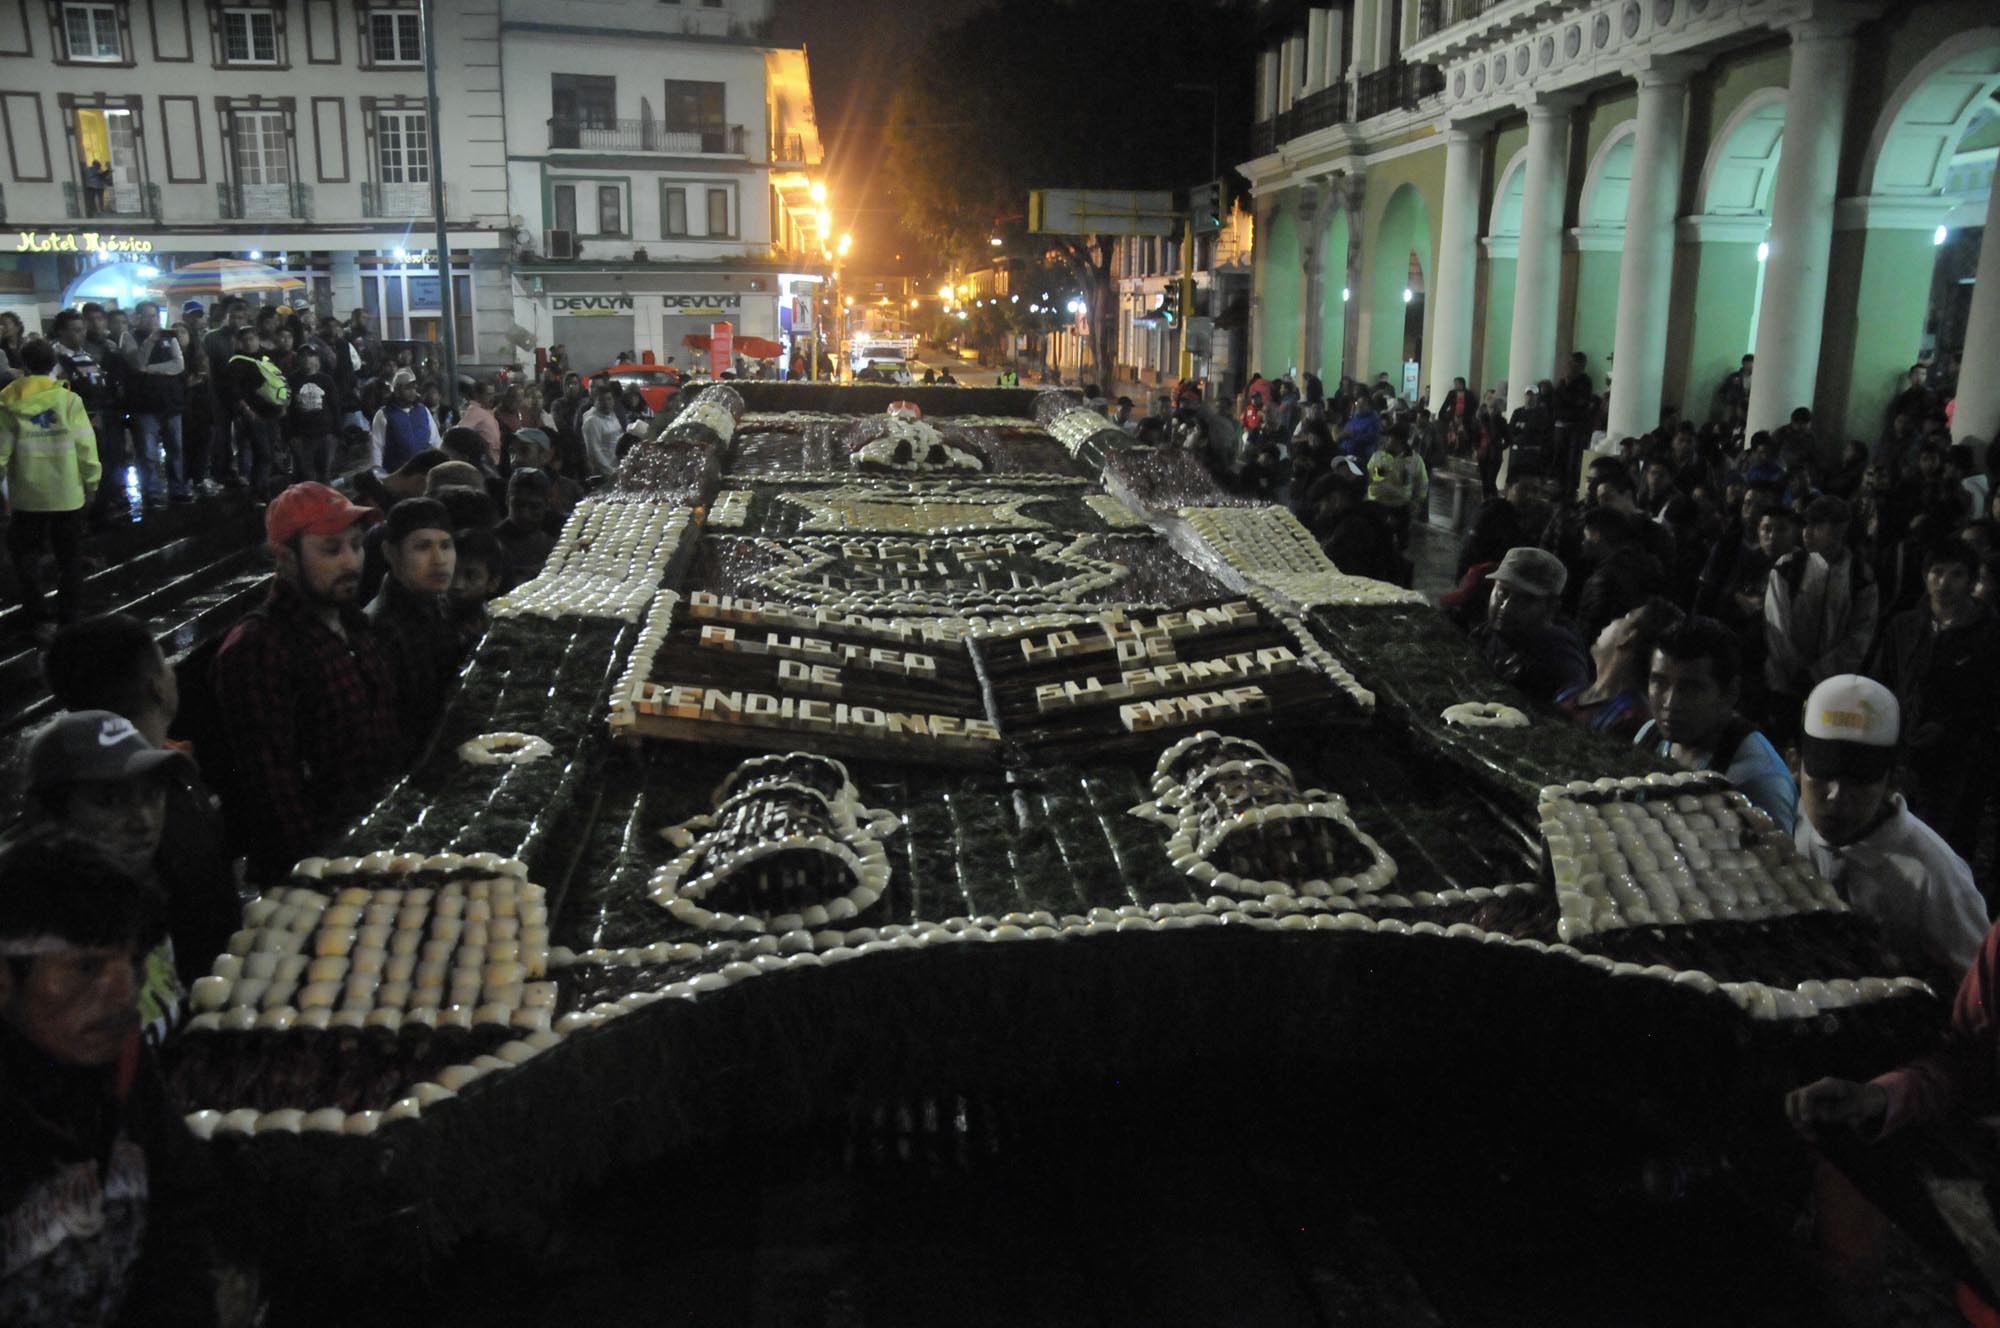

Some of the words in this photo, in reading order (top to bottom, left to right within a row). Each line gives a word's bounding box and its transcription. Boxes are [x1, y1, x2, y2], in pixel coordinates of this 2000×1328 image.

[17, 232, 78, 252] Hotel
[83, 232, 152, 252] México
[553, 297, 633, 310] DEVLYN
[663, 295, 741, 308] DEVLYN
[689, 591, 790, 619] DIOS
[701, 625, 735, 648] A
[767, 633, 937, 672] USTED
[1020, 631, 1080, 659] LO
[1117, 637, 1176, 663] DE
[778, 659, 842, 691] DE
[1036, 676, 1103, 703] SU
[1122, 646, 1297, 688] SANTO
[631, 681, 1000, 740] BENDICIONES
